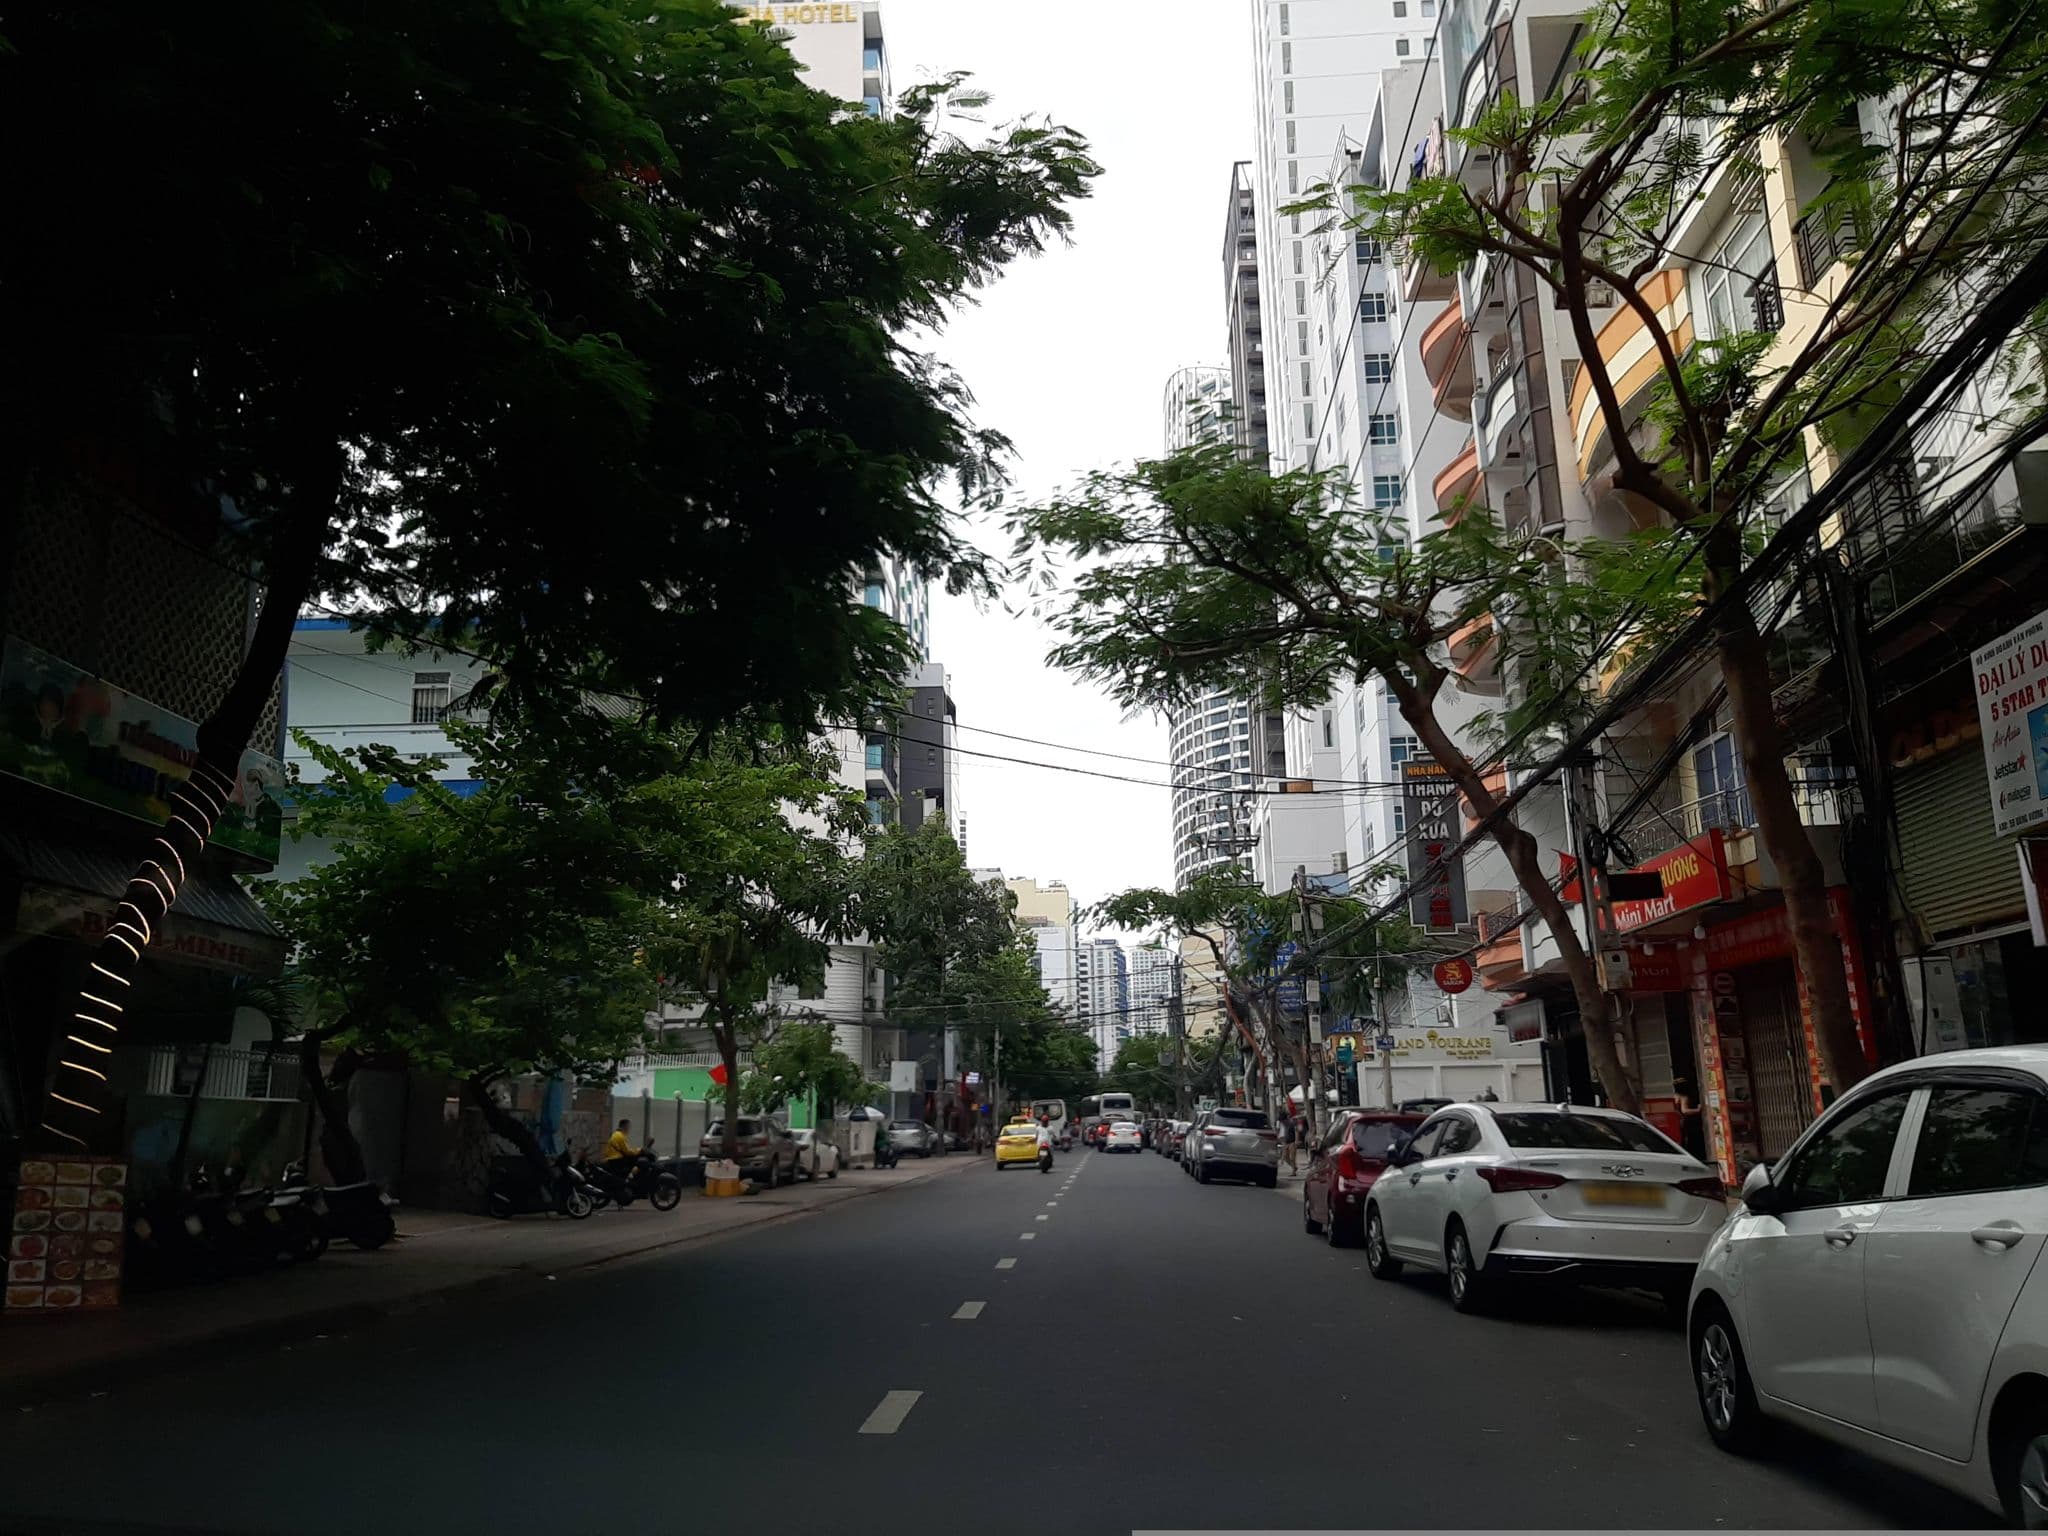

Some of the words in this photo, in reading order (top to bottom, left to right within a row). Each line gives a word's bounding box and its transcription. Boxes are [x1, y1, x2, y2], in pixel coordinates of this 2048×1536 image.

[783, 4, 857, 24] HOTEL
[1978, 663, 2005, 696] ĐẠI
[2007, 645, 2026, 680] LÝ
[1990, 702, 1999, 721] 5
[2001, 684, 2035, 717] STAR
[2037, 675, 2048, 698] T
[1614, 903, 1642, 931] Mini
[1644, 892, 1676, 922] Mart
[1393, 1037, 1424, 1049] AND
[1429, 1036, 1491, 1049] TOURANE
